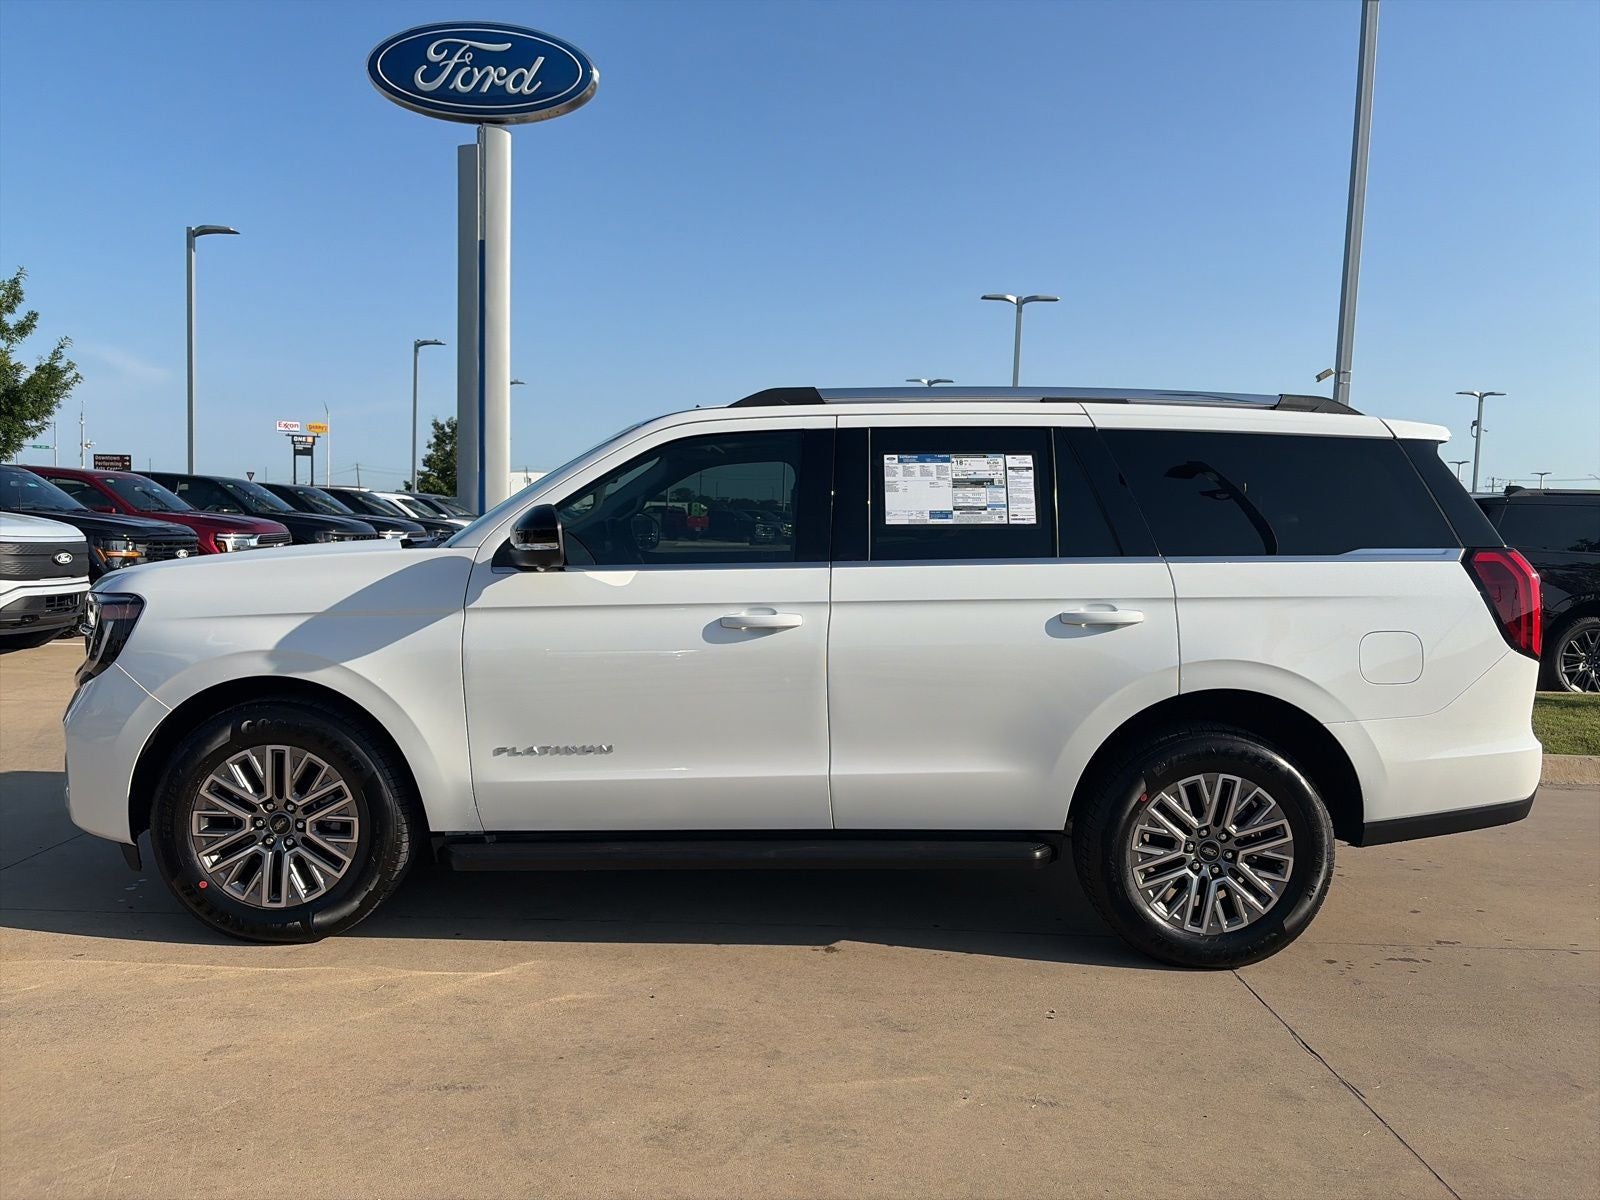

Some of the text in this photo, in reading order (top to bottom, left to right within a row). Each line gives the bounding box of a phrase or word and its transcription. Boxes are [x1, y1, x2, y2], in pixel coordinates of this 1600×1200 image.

[414, 38, 545, 95] Ford
[278, 422, 299, 430] Exxon
[492, 744, 614, 757] PLATINUM
